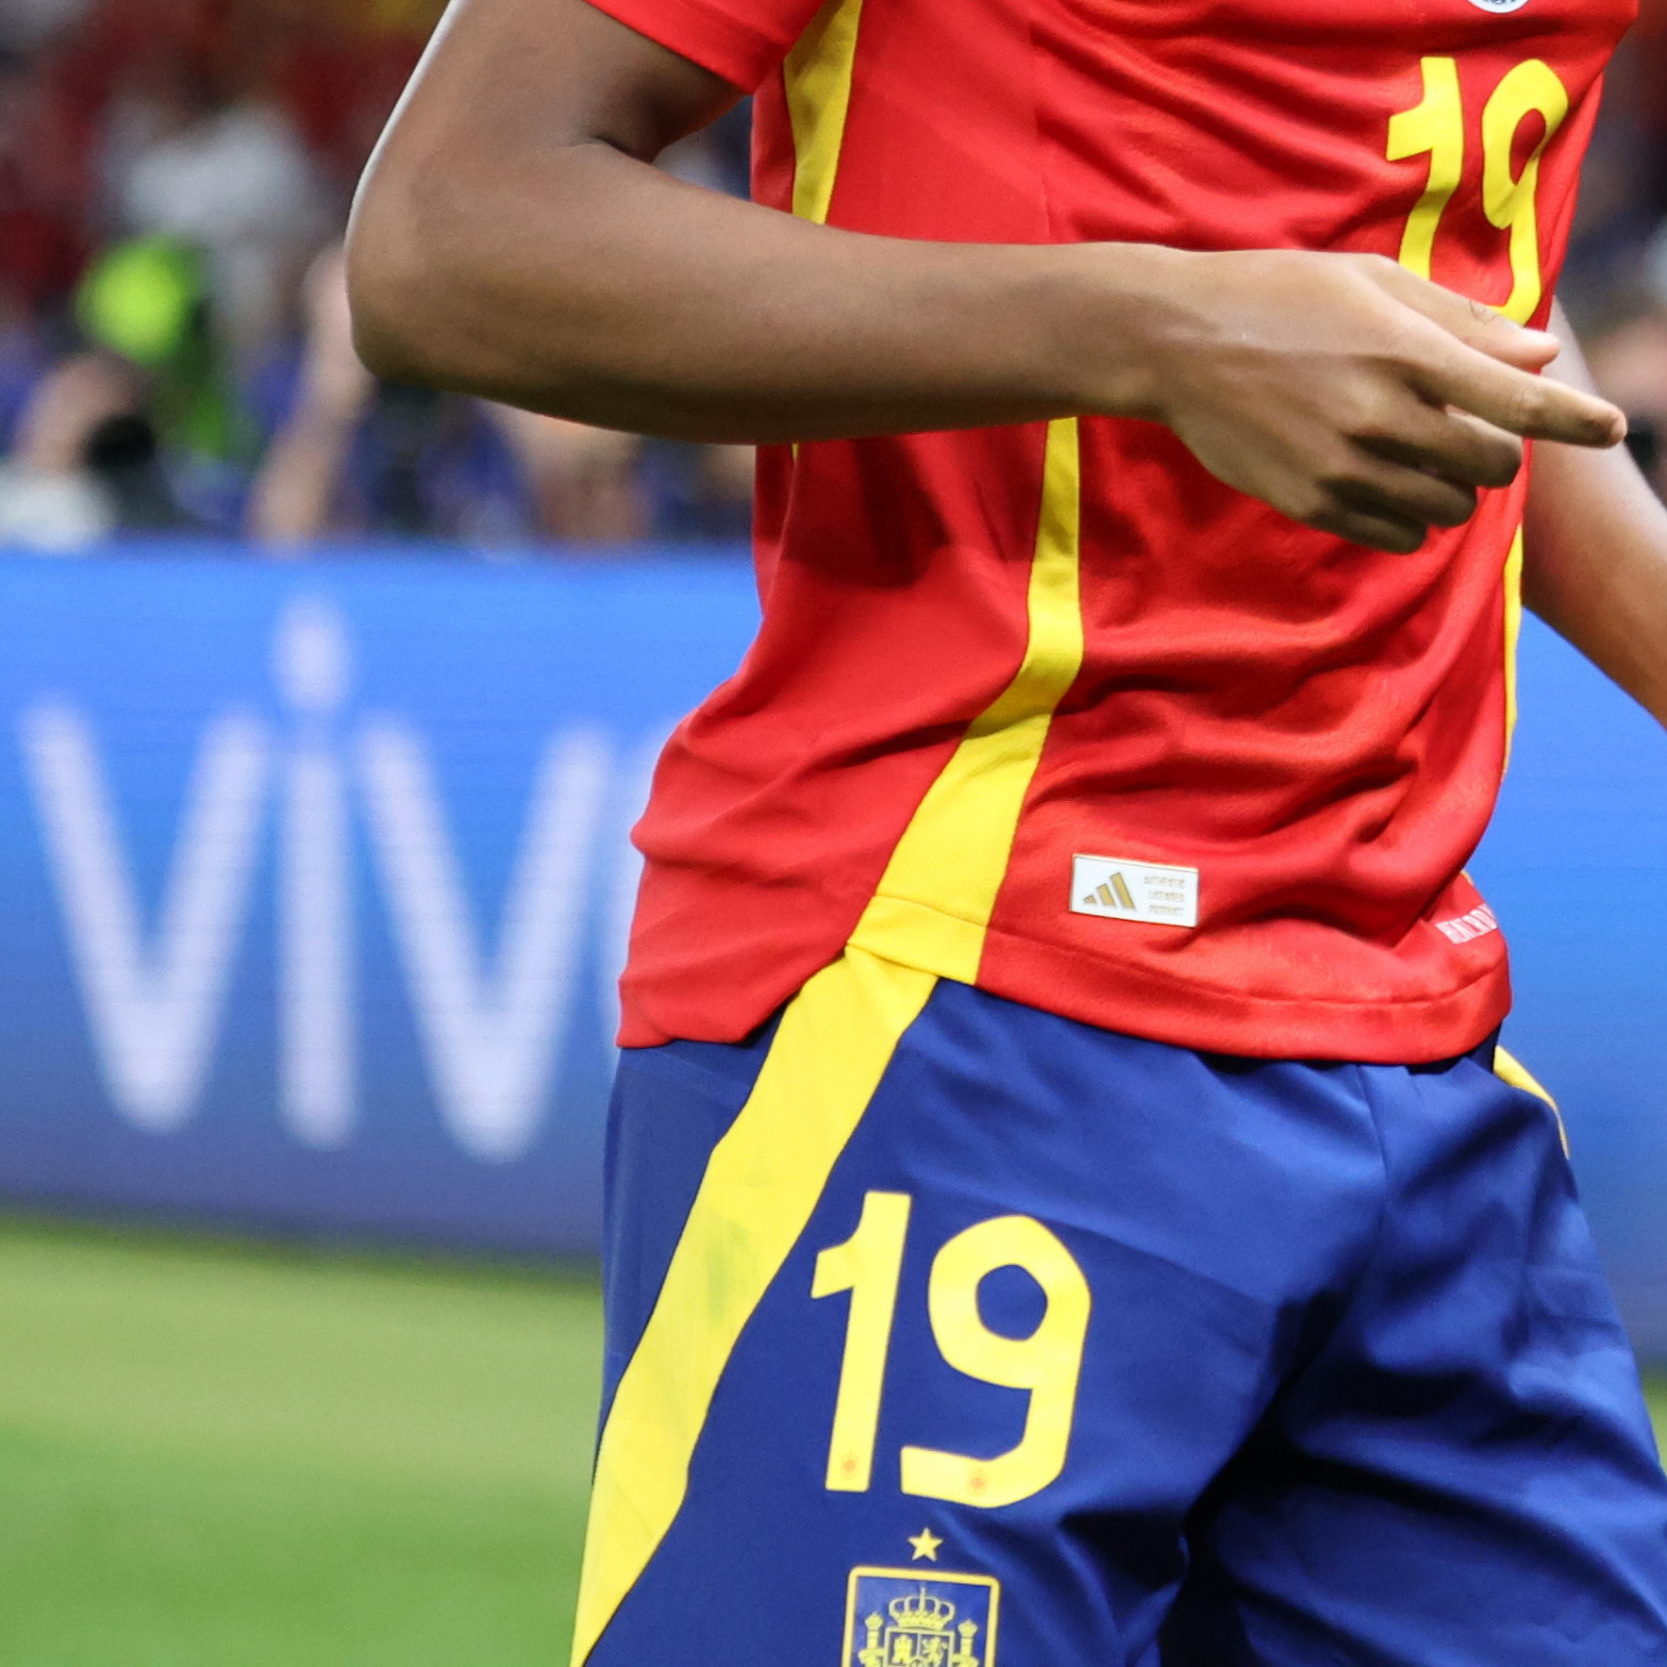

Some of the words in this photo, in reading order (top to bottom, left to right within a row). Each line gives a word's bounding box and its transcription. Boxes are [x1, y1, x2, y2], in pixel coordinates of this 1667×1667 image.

[1386, 56, 1569, 326] 19
[22, 594, 650, 1160] viv
[811, 1189, 1092, 1509] 19
